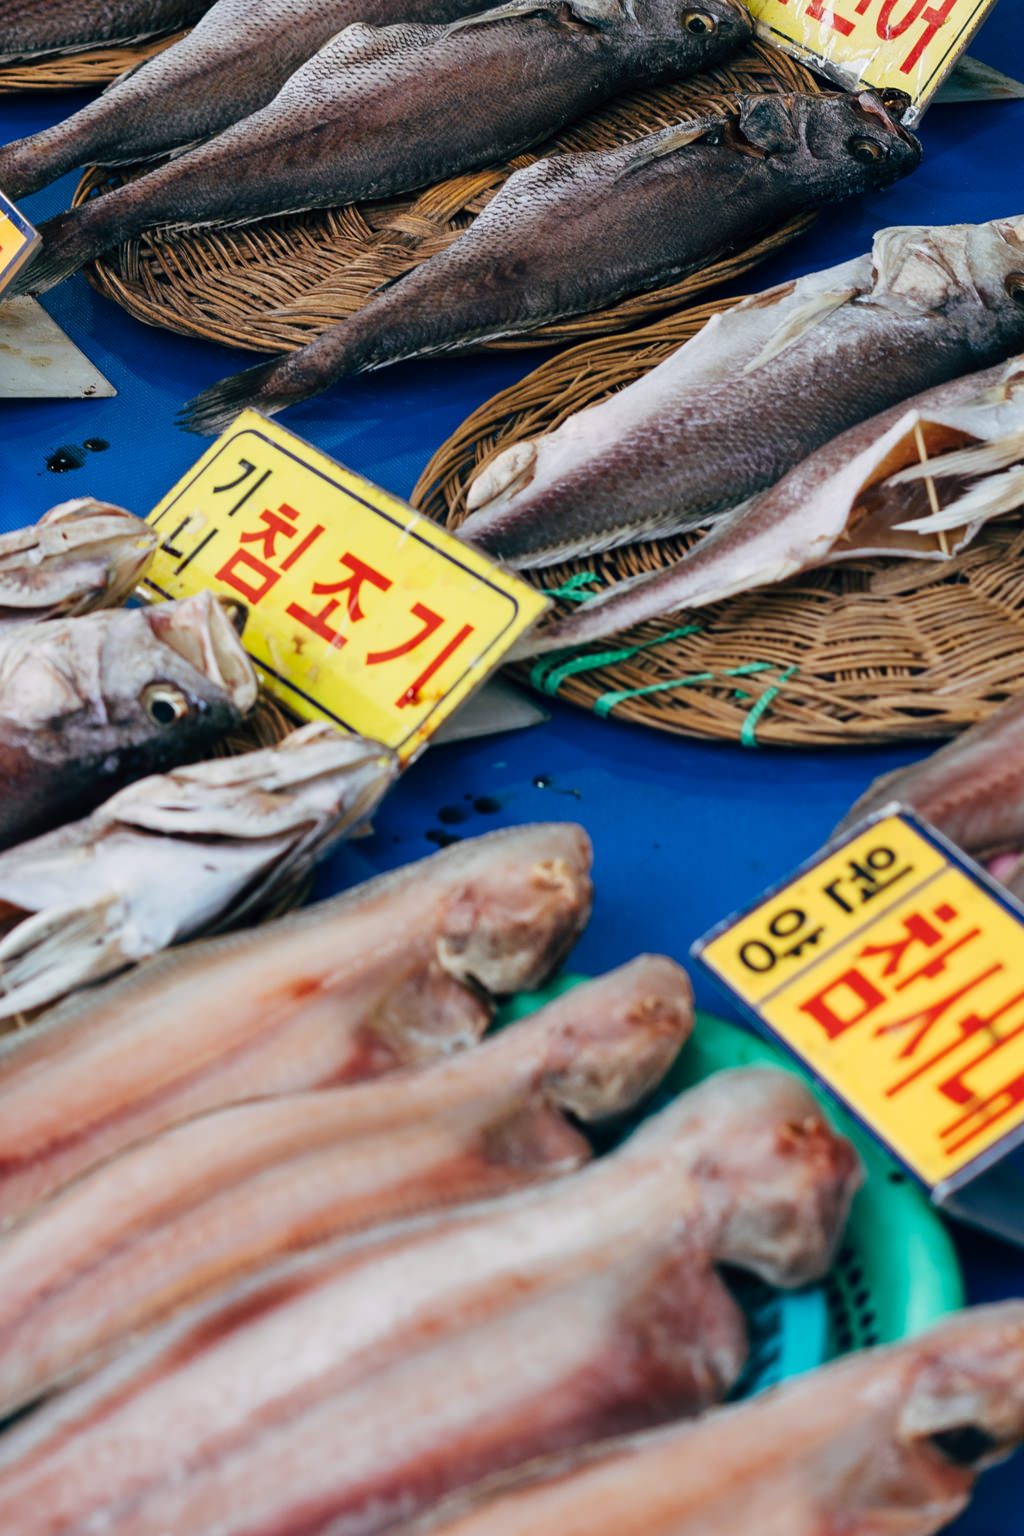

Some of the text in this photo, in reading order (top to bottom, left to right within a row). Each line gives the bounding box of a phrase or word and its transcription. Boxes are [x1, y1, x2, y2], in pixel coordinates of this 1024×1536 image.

[160, 458, 273, 576] 기니
[214, 503, 475, 710] 침조기
[739, 846, 914, 974] 원양
